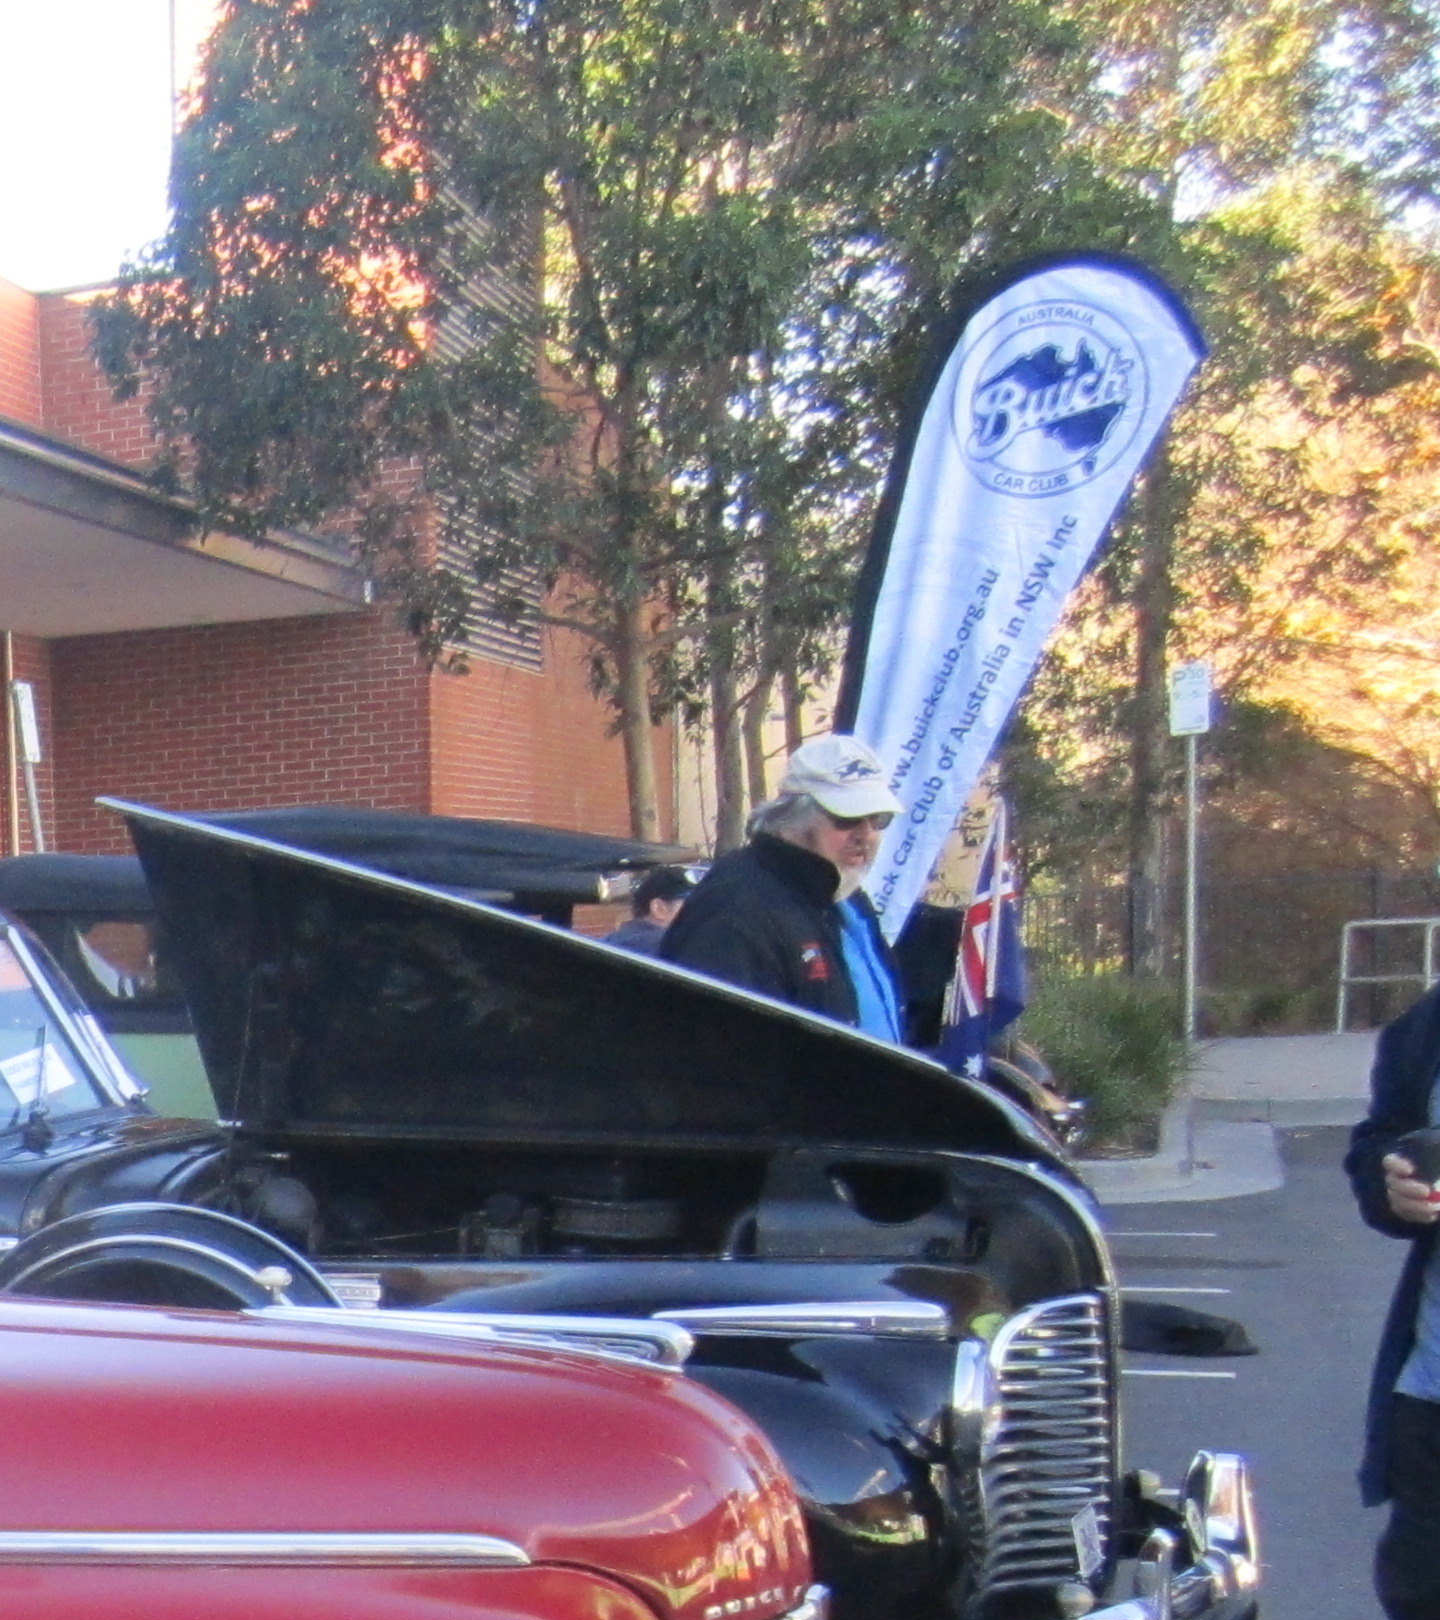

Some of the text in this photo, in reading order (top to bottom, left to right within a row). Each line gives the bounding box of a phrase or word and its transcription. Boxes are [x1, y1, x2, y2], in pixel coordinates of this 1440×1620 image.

[1018, 306, 1095, 328] AUSTRALIA
[966, 348, 1135, 462] Buick
[993, 472, 1069, 492] CAR CLUB
[873, 514, 1079, 916] uick Car Club of Australia in NSW Inc
[887, 568, 1000, 797] ww.buickclub.org.au
